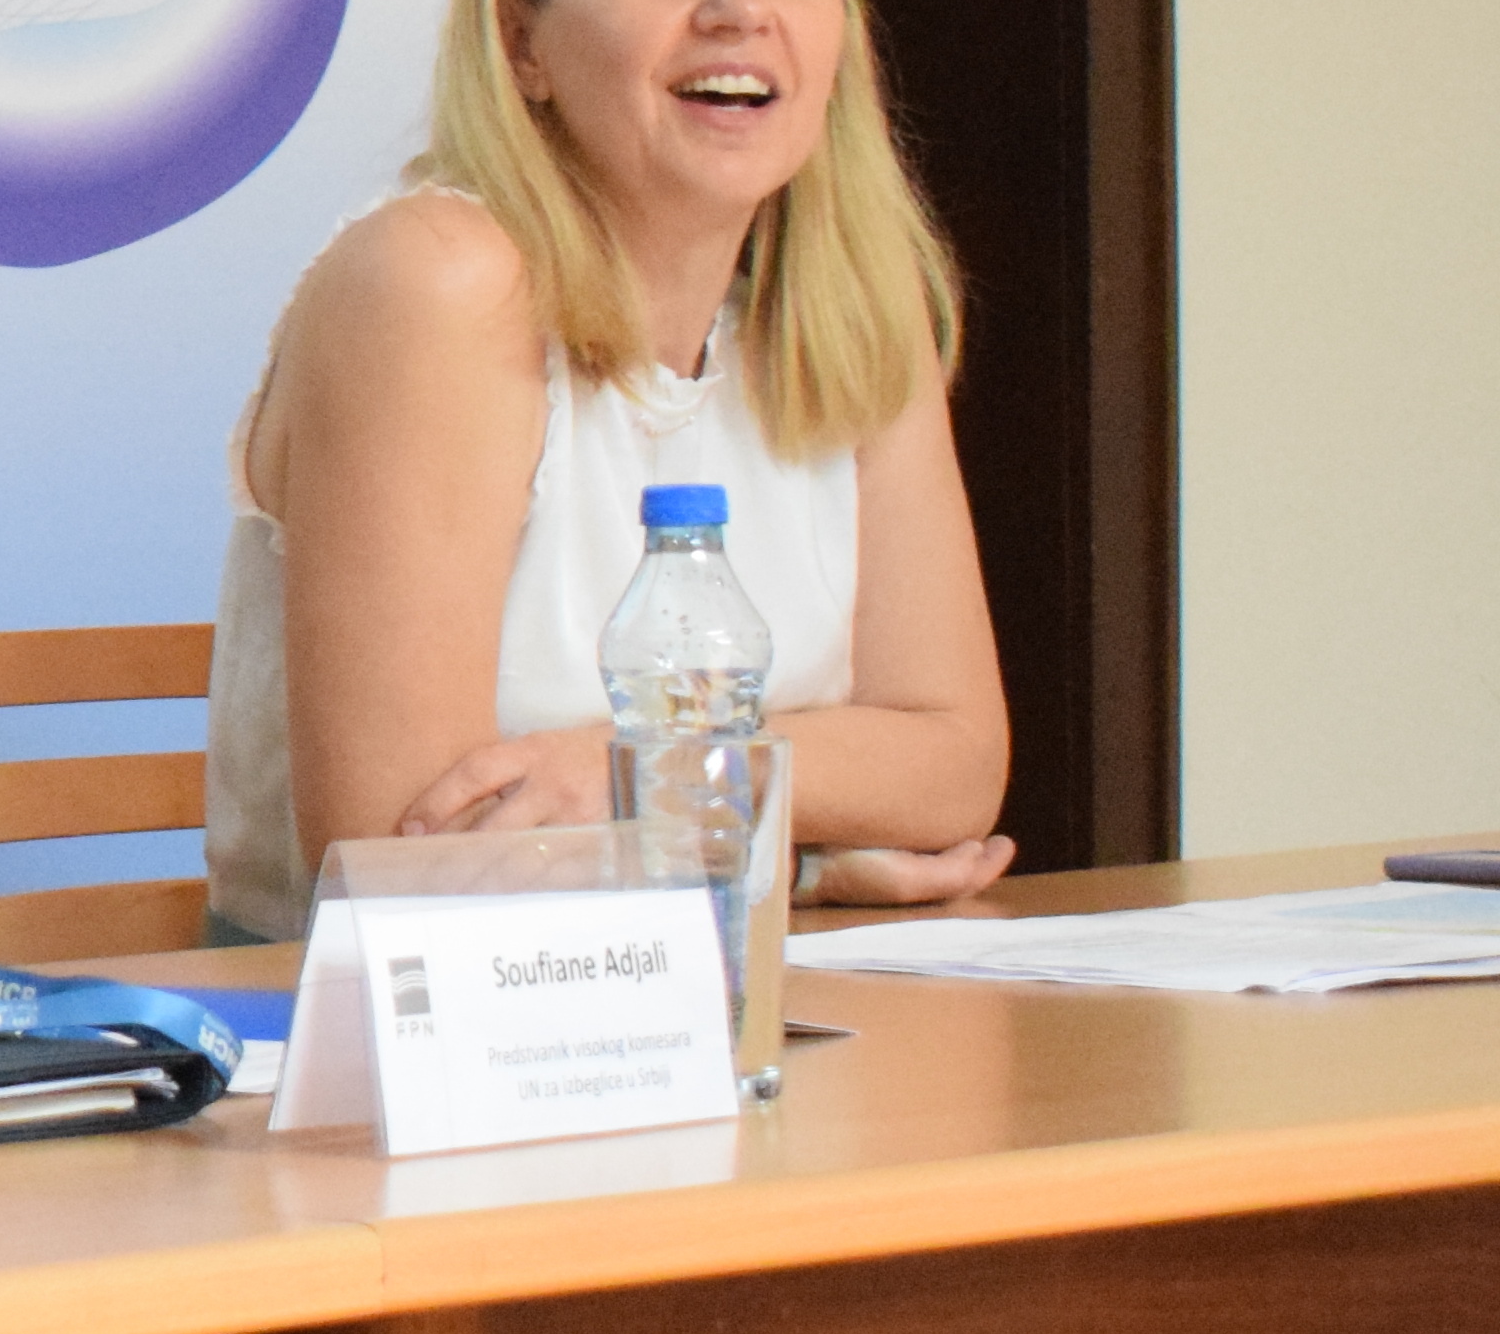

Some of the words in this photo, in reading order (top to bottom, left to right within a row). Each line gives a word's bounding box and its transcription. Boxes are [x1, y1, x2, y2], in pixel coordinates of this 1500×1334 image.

[493, 950, 597, 989] Soufiane
[604, 941, 669, 988] Adjali
[518, 1078, 541, 1100] UN
[545, 1078, 560, 1097] za
